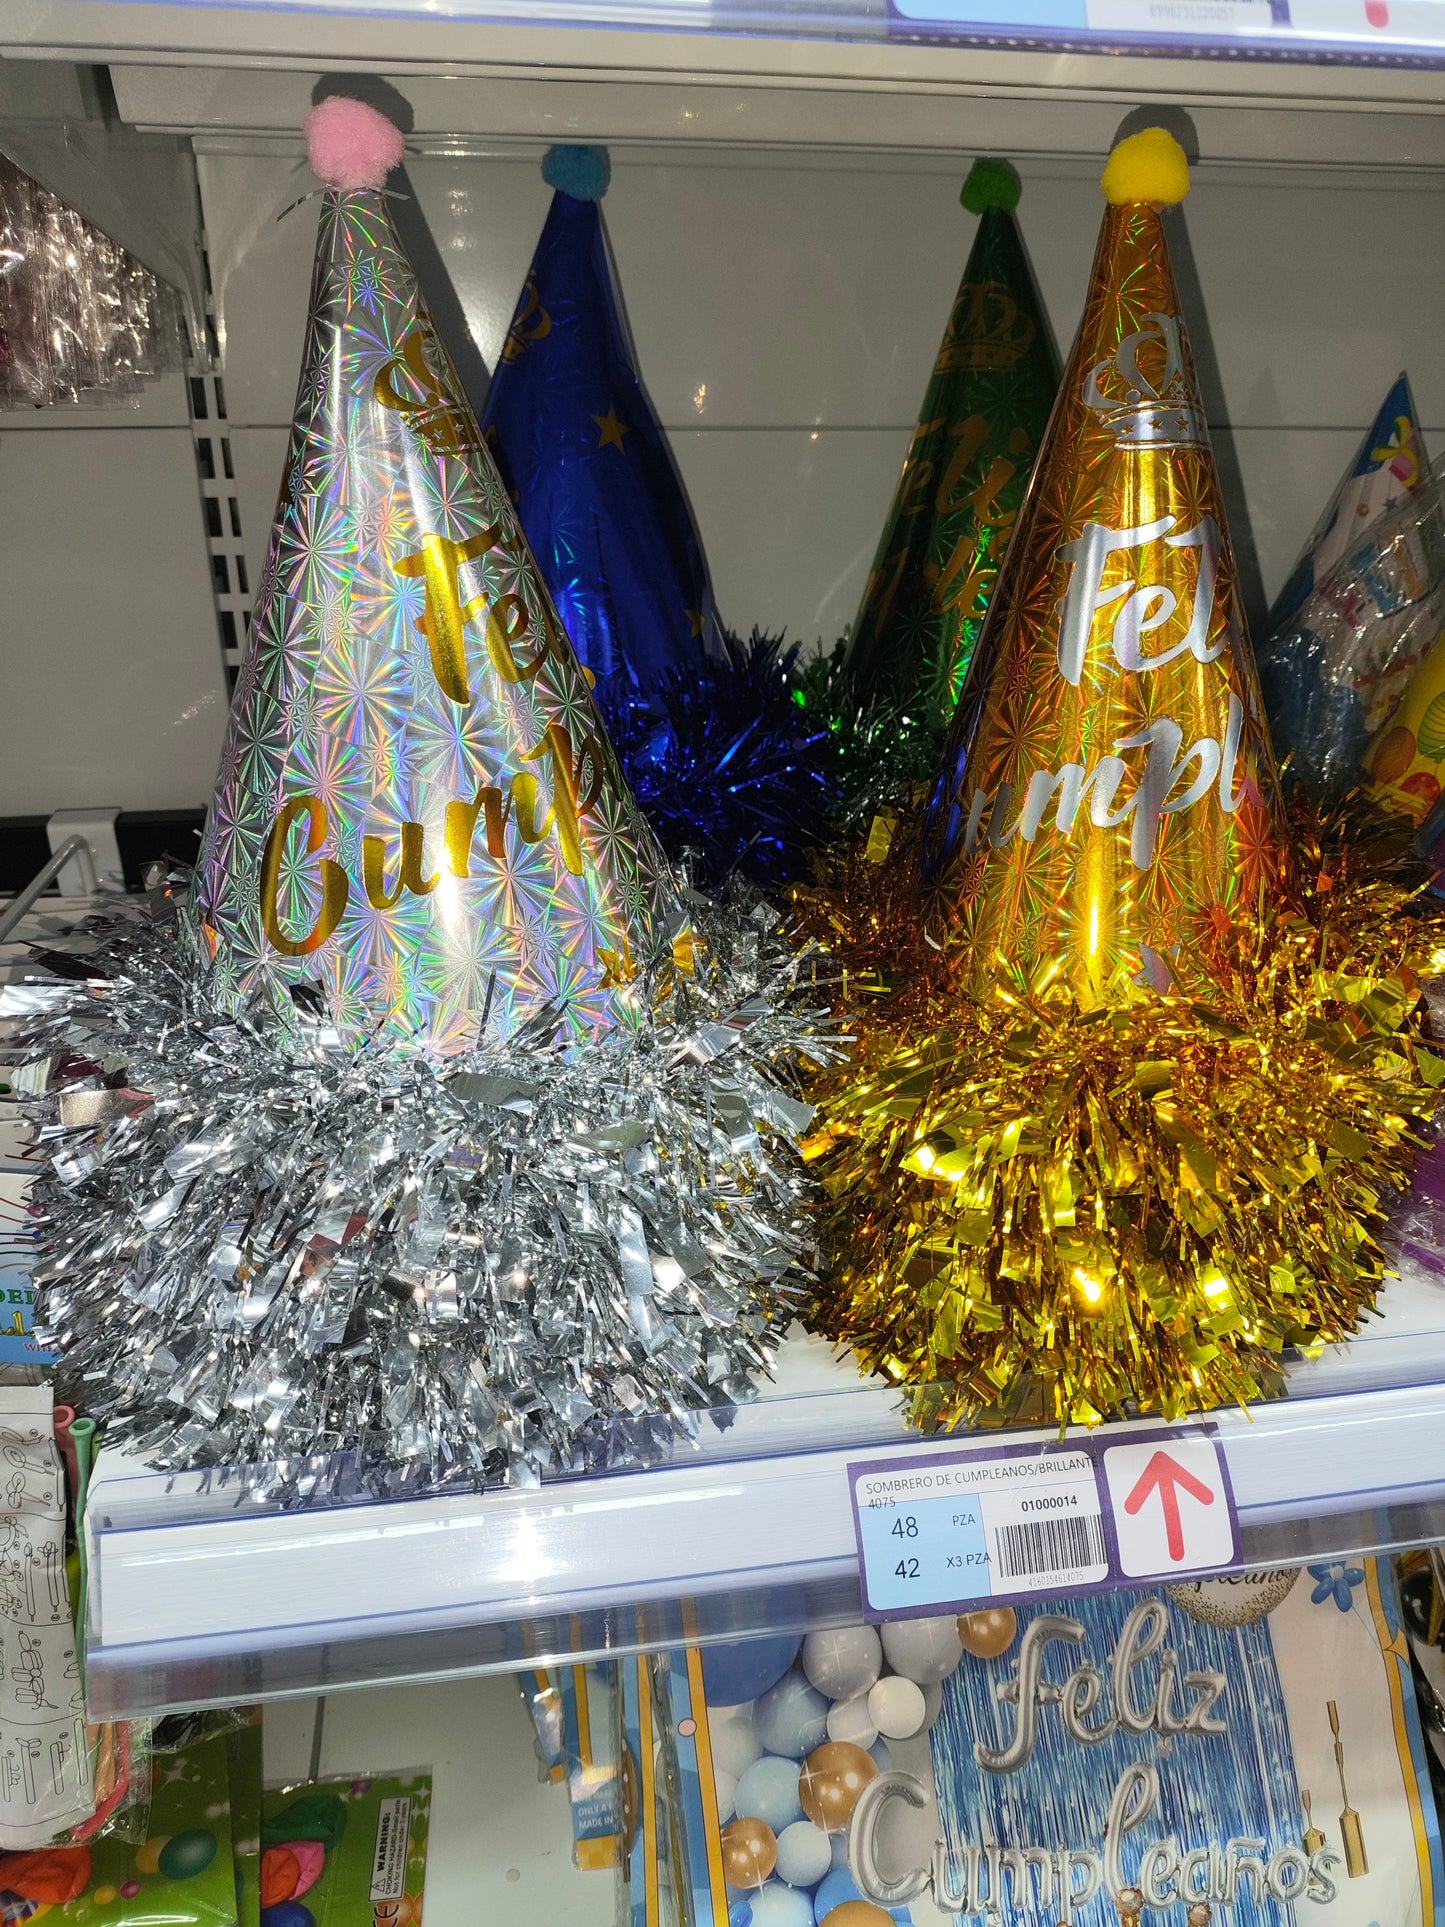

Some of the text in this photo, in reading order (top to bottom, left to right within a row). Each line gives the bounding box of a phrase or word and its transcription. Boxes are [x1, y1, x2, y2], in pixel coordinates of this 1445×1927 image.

[865, 1475, 933, 1495] SOMBRERO
[936, 1473, 951, 1486] DE
[868, 1496, 896, 1510] 4075
[1021, 1495, 1078, 1512] 01000014
[891, 1513, 976, 1539] 48 PZA
[894, 1551, 992, 1579] 42 X3 PZA
[579, 1816, 603, 1829] MADE
[604, 1814, 613, 1826] IN
[376, 1812, 391, 1872] WARNING:
[848, 1762, 1344, 1924] Cumpleaños
[385, 1863, 394, 1895] CHOKING
